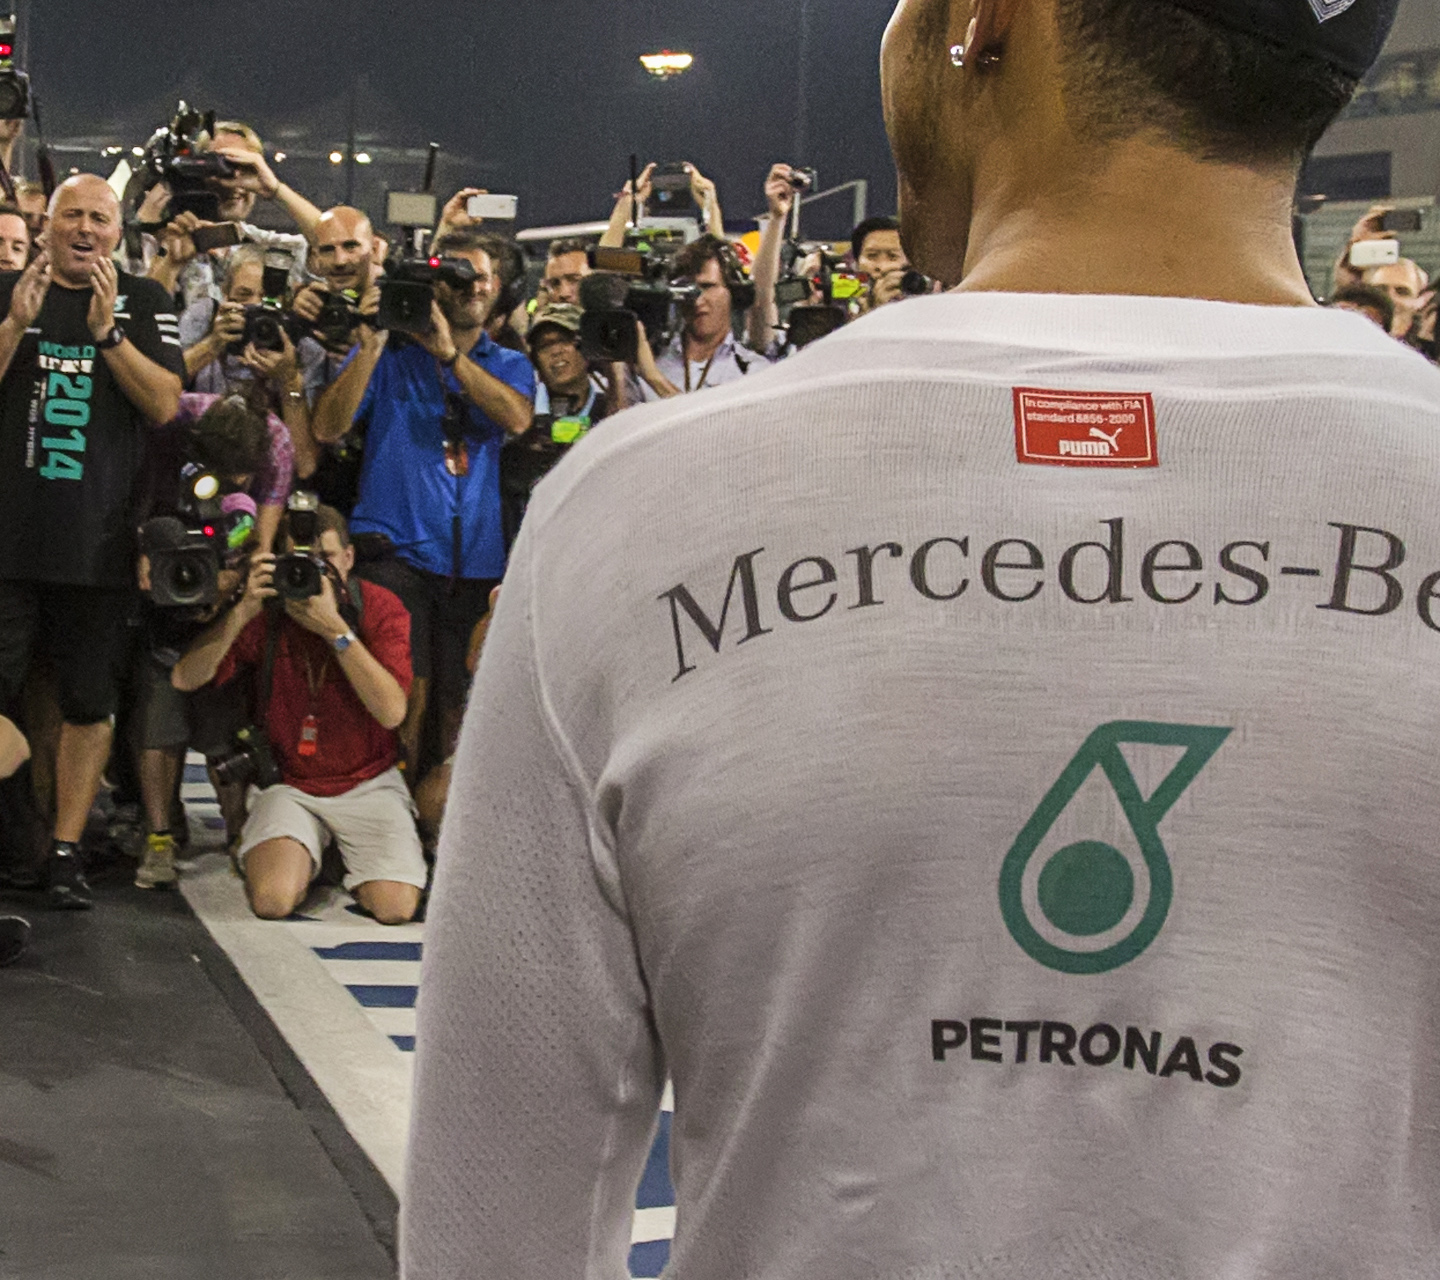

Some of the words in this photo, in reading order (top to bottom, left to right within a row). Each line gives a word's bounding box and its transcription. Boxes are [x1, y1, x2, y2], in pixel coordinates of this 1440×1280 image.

[38, 340, 97, 359] WORLD
[1035, 399, 1099, 412] compliance
[1100, 400, 1123, 410] with
[1124, 400, 1142, 410] FIA
[38, 372, 94, 481] 2014
[1026, 412, 1075, 424] standard
[1058, 439, 1111, 457] PUMA
[930, 1018, 1243, 1088] PETRONAS
